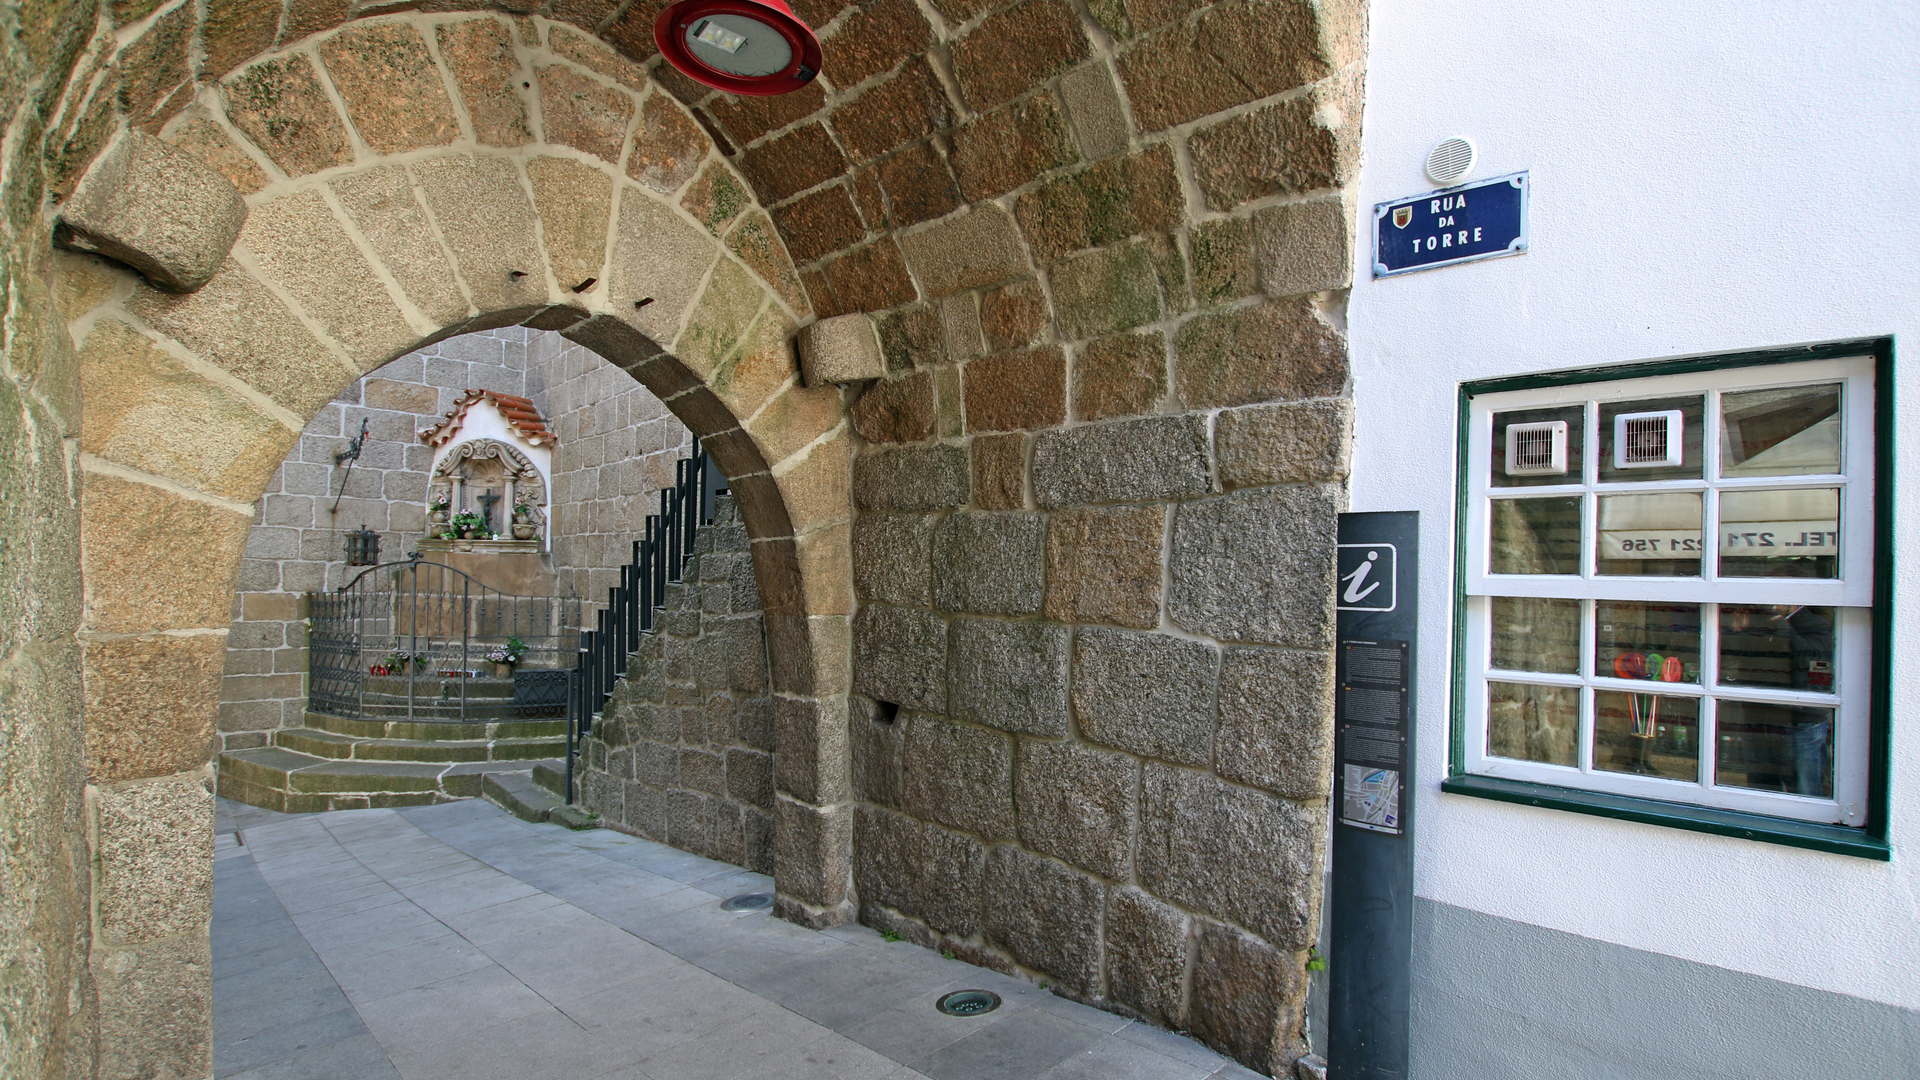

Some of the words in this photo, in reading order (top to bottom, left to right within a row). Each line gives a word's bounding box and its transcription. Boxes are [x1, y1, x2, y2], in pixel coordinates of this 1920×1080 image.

[1430, 194, 1466, 214] RUA
[1438, 215, 1455, 228] DA
[1412, 226, 1482, 253] TORRE
